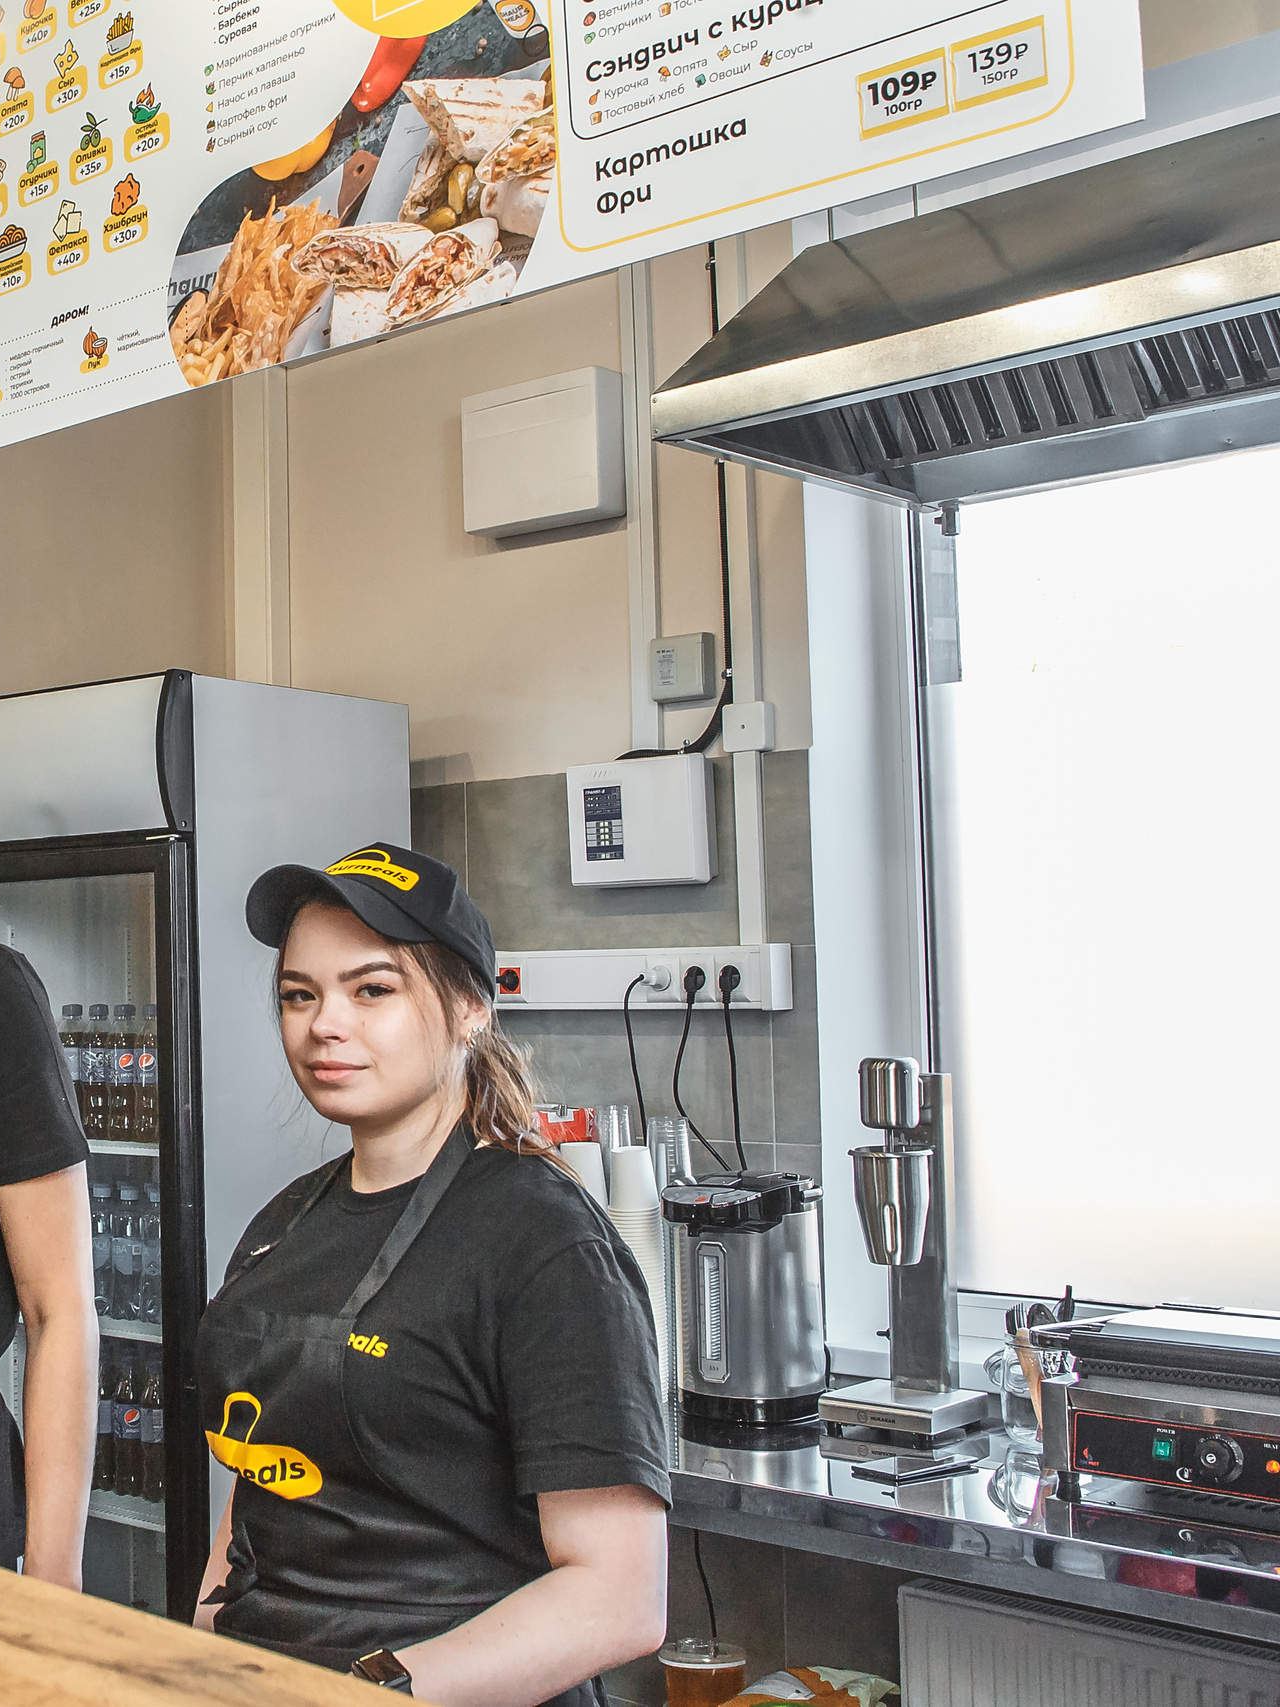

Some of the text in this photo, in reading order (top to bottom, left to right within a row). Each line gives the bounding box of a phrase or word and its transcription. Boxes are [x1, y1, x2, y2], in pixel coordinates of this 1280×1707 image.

[20, 13, 53, 36] Курочка
[218, 5, 261, 31] Барбекю
[598, 12, 652, 39] Огурчики
[216, 12, 336, 71] Маринованные огурчики
[218, 21, 258, 45] Суровая
[586, 28, 699, 83] Сэндвич
[707, 21, 723, 39] с
[218, 46, 306, 91] Перчик халапеньо
[603, 38, 759, 101] Курочка Опята Сыр
[604, 41, 814, 120] Тостовый хлеб Овощи Соусы
[981, 66, 1018, 86] 150гр
[57, 77, 75, 91] Сыр
[217, 70, 296, 110] Начос из лаваша
[1, 99, 28, 117] Опята
[217, 93, 288, 129] Картофель фри
[884, 97, 923, 117] 100гр
[217, 116, 278, 148] Сырный соус
[75, 145, 107, 164] Оливки
[594, 118, 747, 182] Картошка
[19, 166, 58, 189] Огурчики
[596, 183, 652, 215] Фри
[103, 210, 148, 234] Хэшбраун
[48, 235, 88, 257] Фетакса
[50, 305, 90, 329] ДАРОМ!
[117, 331, 166, 353] маринованный
[9, 369, 31, 382] острый
[87, 359, 101, 370] Лук
[10, 382, 51, 401] 1000 островов
